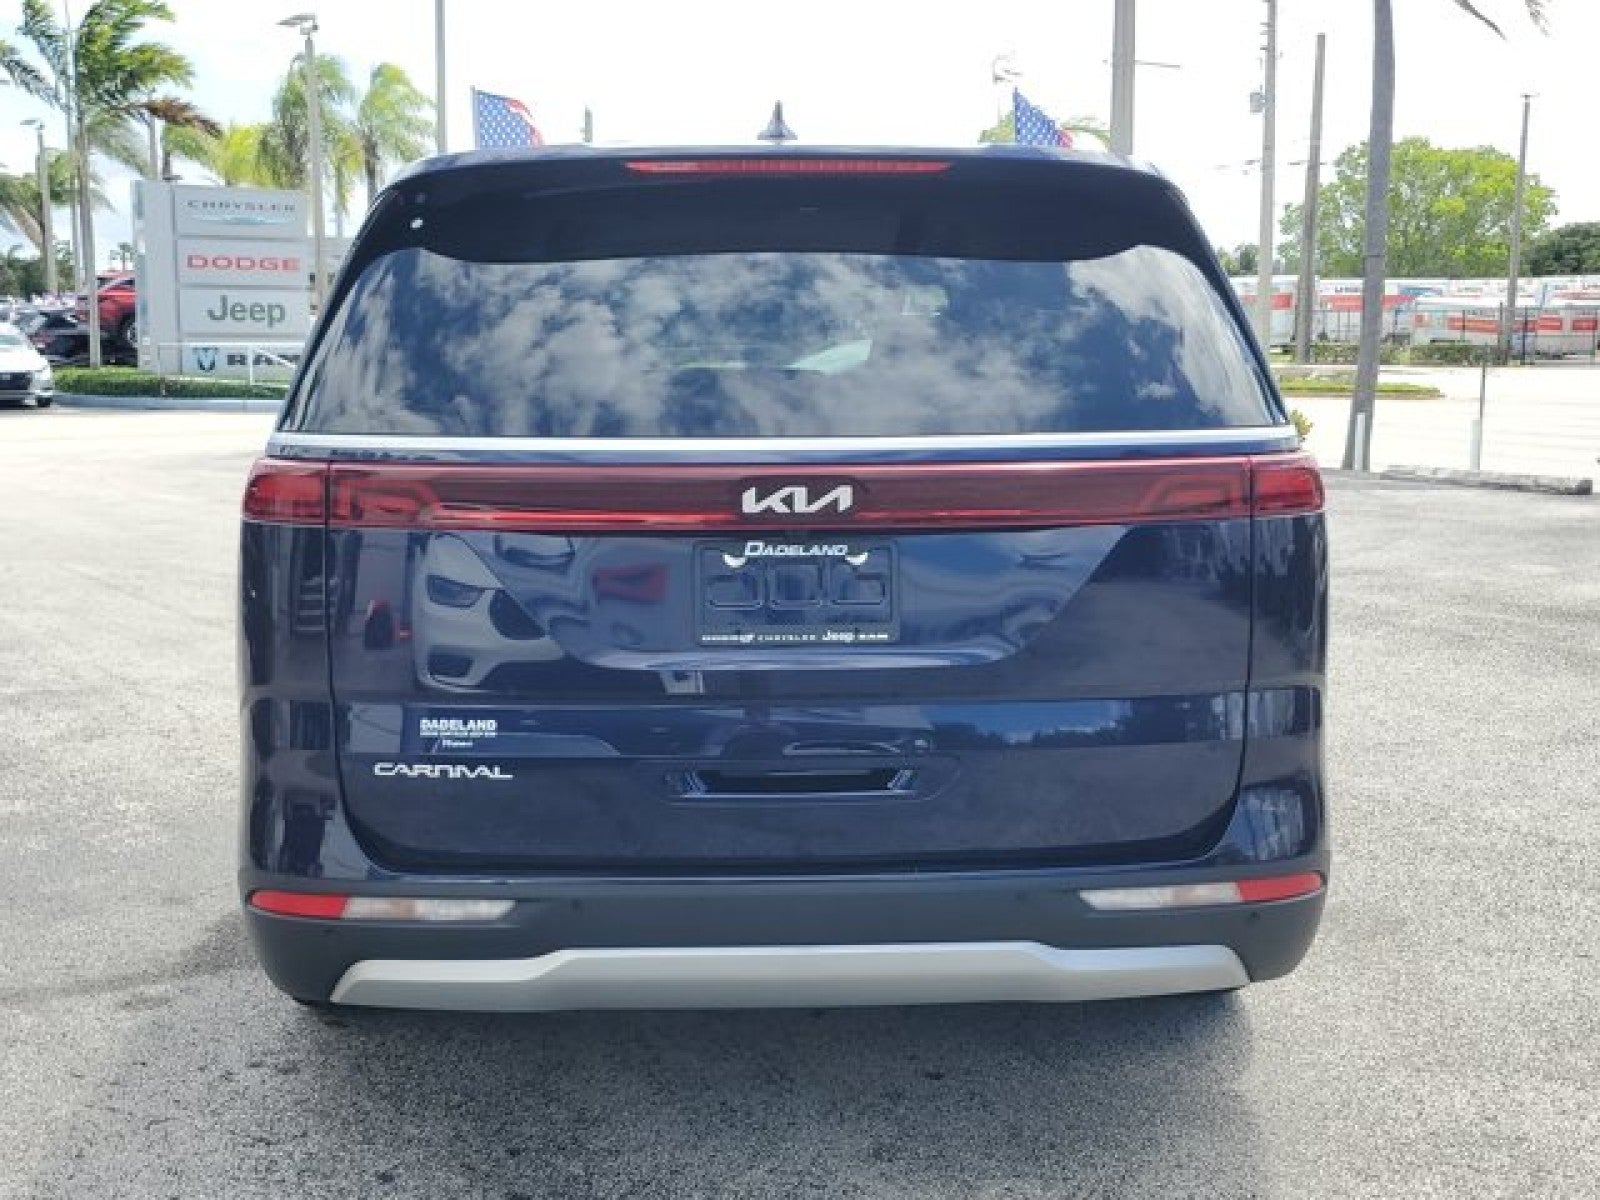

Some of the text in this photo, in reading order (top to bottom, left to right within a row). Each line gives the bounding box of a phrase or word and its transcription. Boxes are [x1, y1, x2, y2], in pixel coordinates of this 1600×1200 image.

[186, 254, 301, 271] DODGE
[207, 294, 286, 328] Jeep
[742, 485, 854, 513] KIA
[419, 718, 497, 731] DADELAND
[374, 762, 514, 780] CARNIVAL
